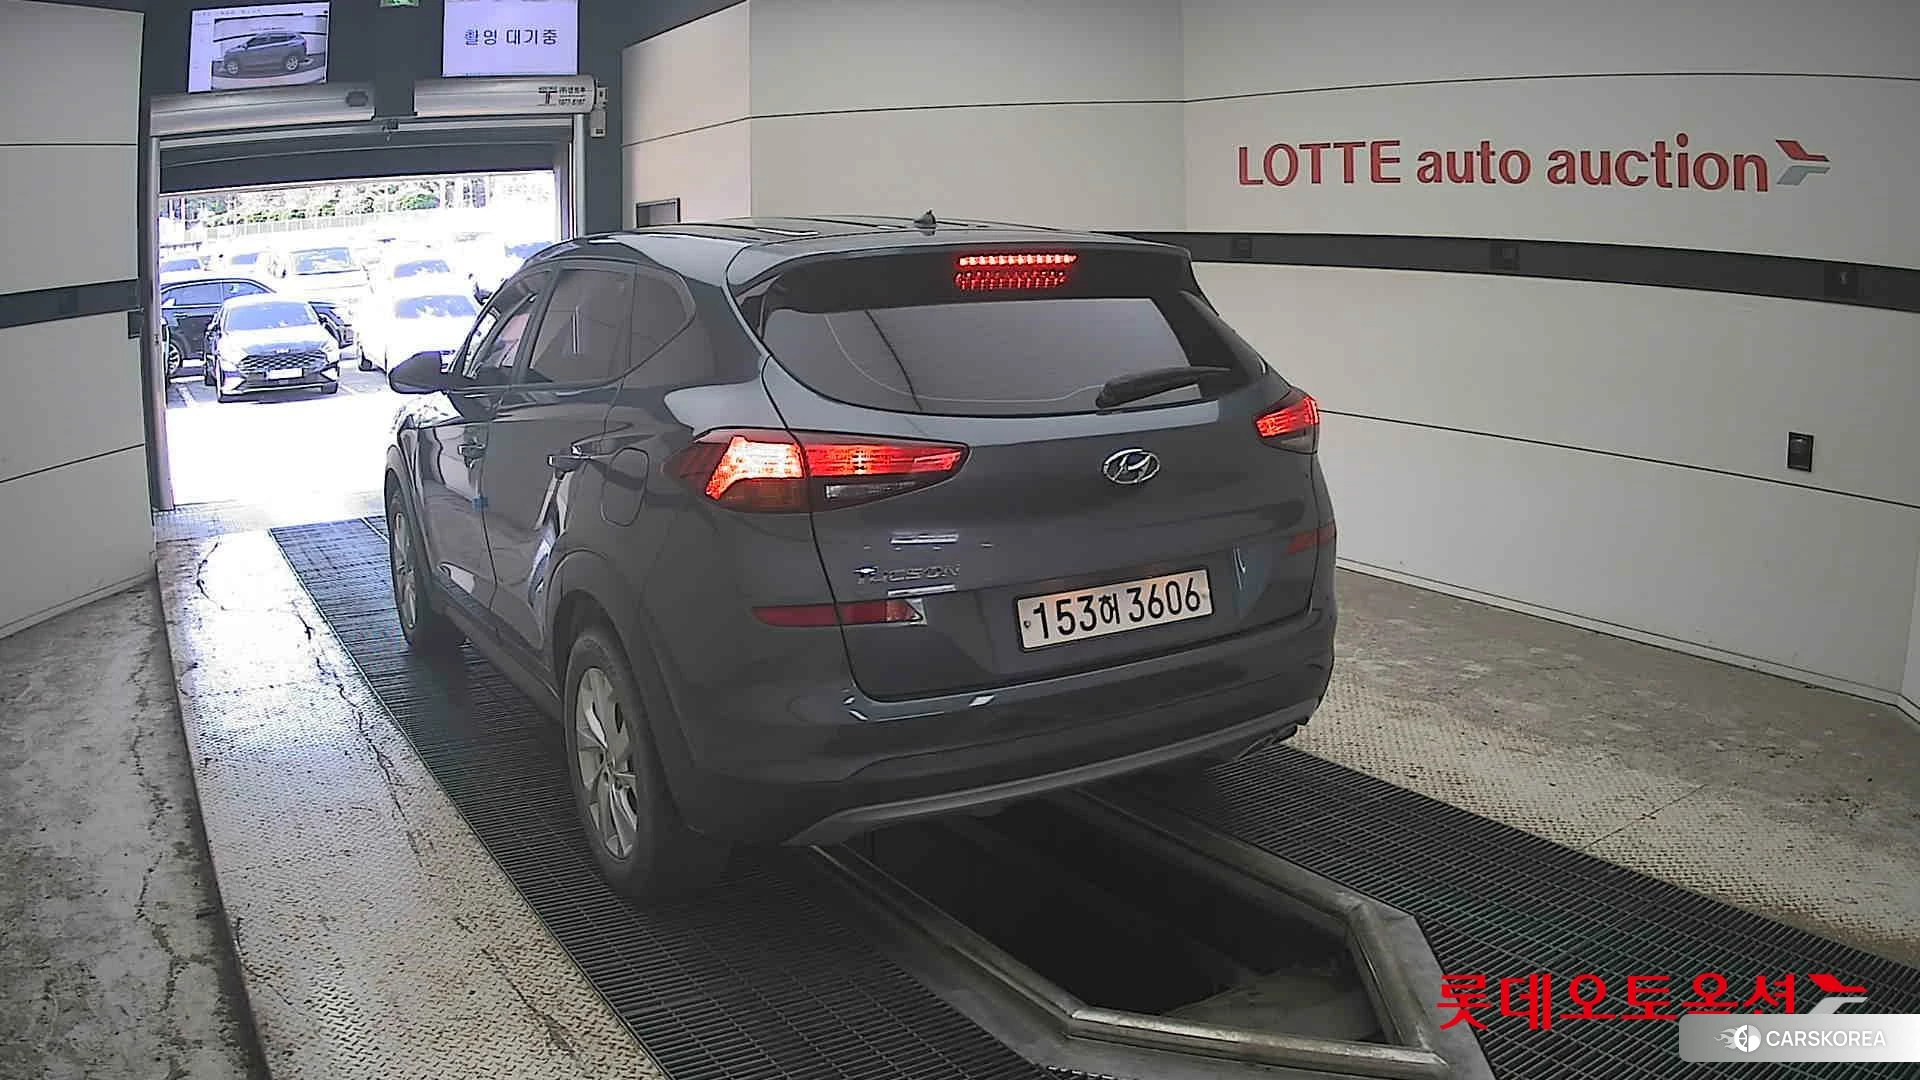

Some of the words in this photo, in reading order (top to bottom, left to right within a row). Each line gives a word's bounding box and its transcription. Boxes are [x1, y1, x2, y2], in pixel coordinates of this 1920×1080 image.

[505, 29, 559, 46] 대기중
[1238, 139, 1401, 187] LOTTE
[1416, 139, 1532, 185] auto
[1546, 132, 1769, 193] auction
